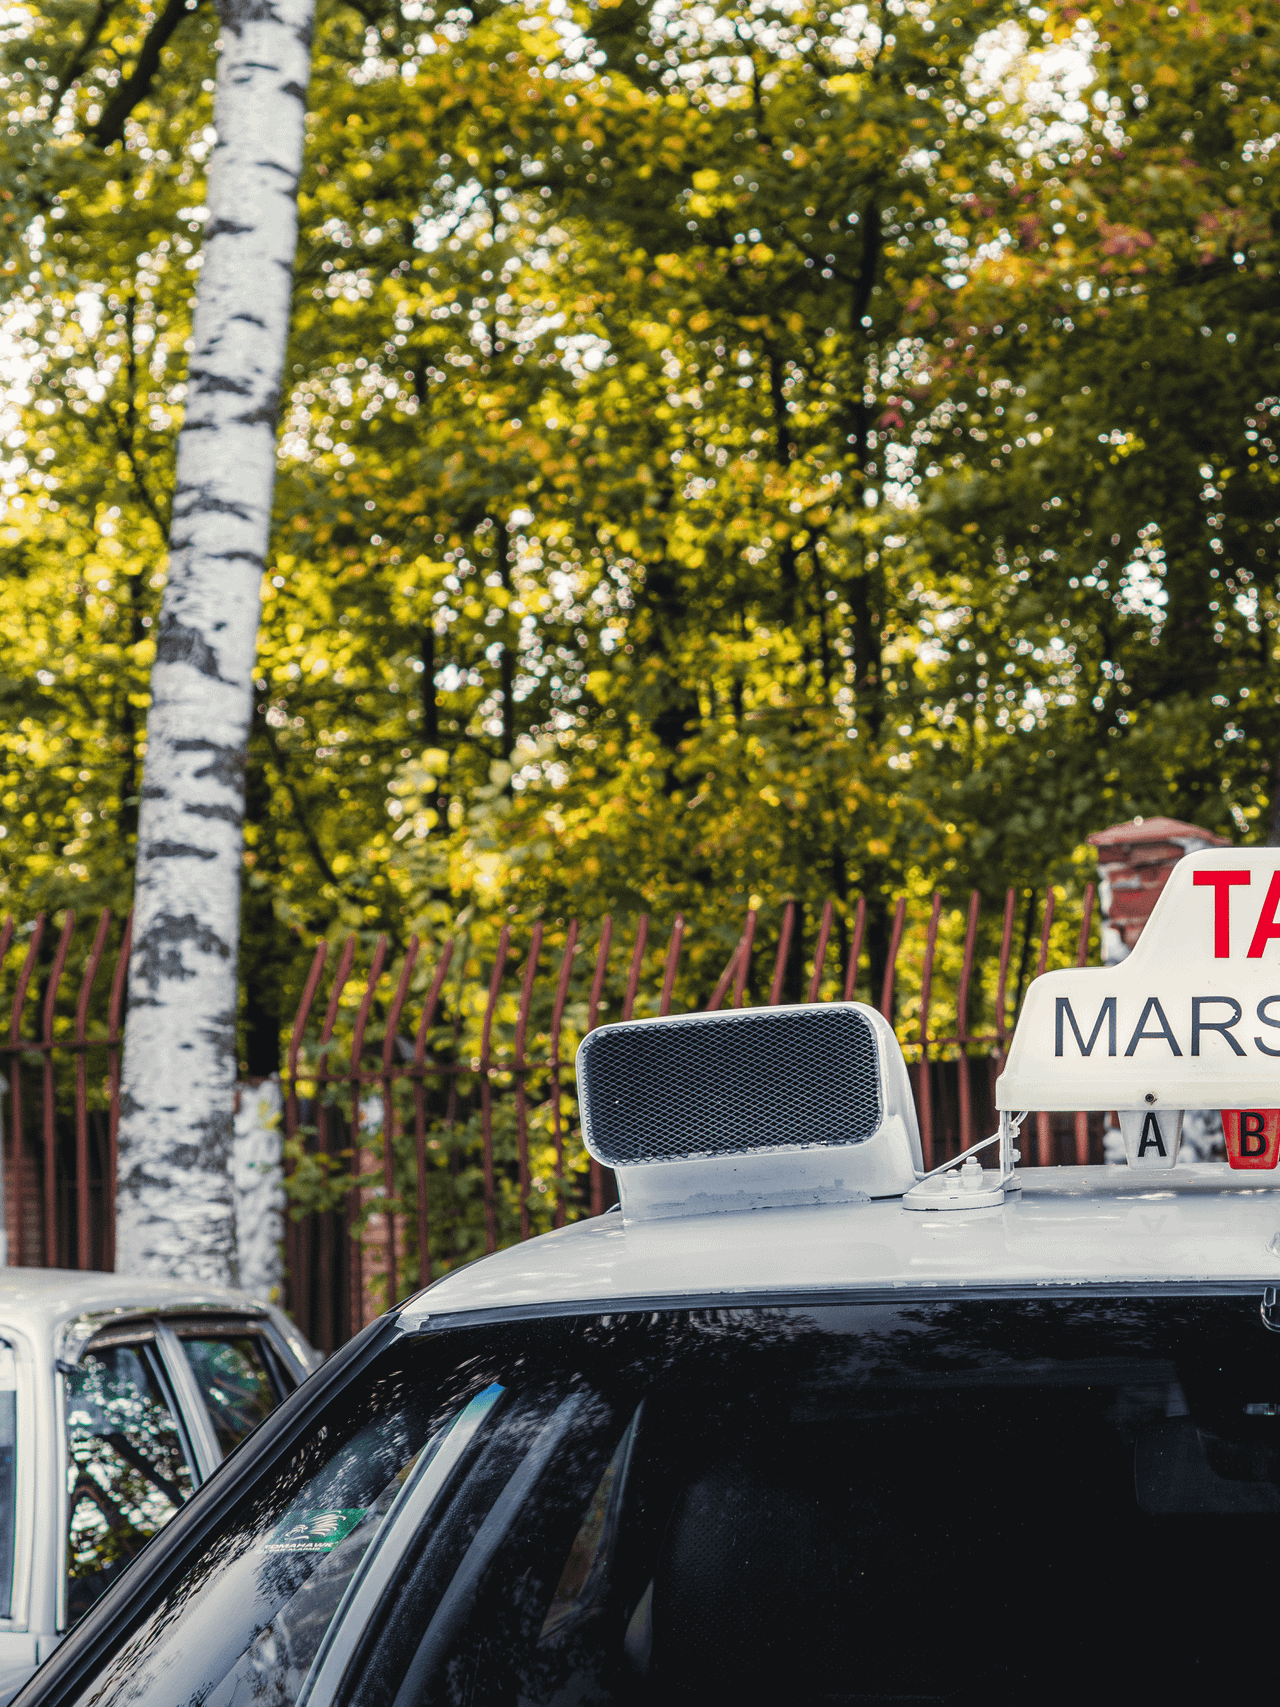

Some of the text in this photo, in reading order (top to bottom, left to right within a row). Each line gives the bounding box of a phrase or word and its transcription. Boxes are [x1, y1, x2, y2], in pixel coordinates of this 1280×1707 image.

[1137, 1111, 1167, 1158] A
[1240, 1111, 1270, 1158] B
[264, 1542, 334, 1550] TOMAHAWK
